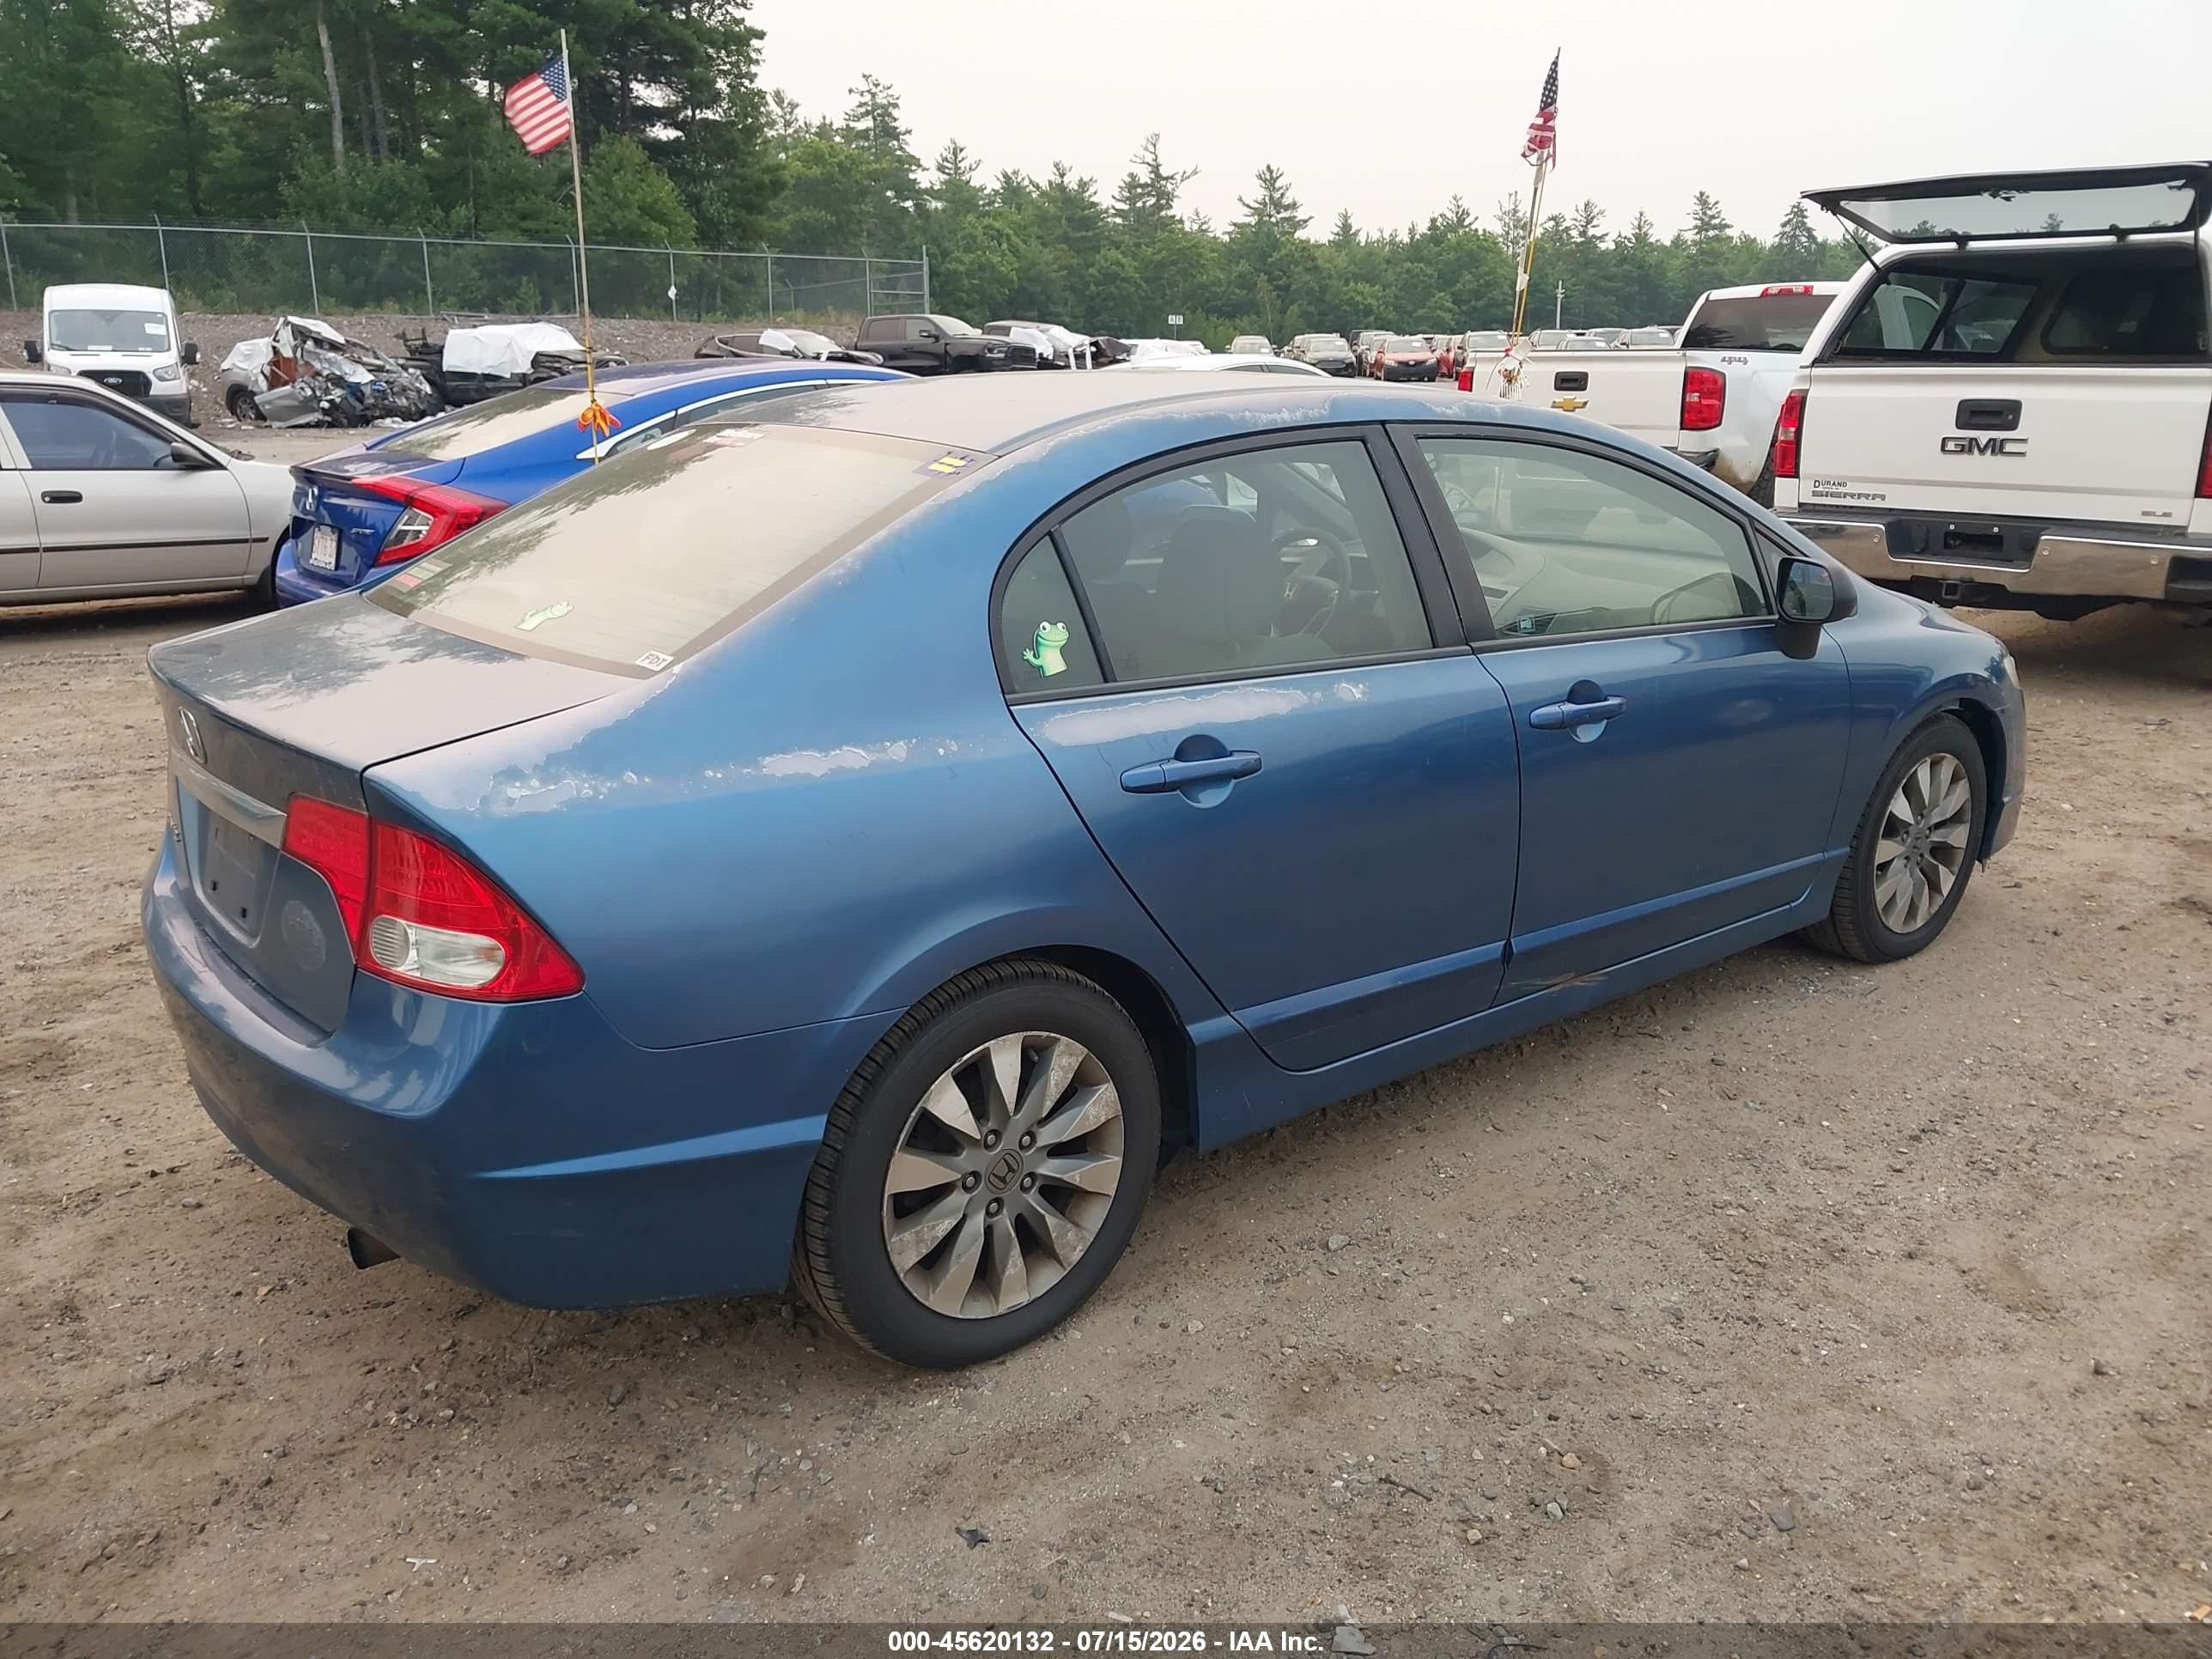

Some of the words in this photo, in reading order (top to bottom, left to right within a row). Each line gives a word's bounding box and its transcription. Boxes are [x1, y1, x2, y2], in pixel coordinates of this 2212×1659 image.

[1941, 436, 2028, 457] GMC
[1814, 480, 1848, 489] DURAND
[1812, 490, 1887, 501] SIERRA
